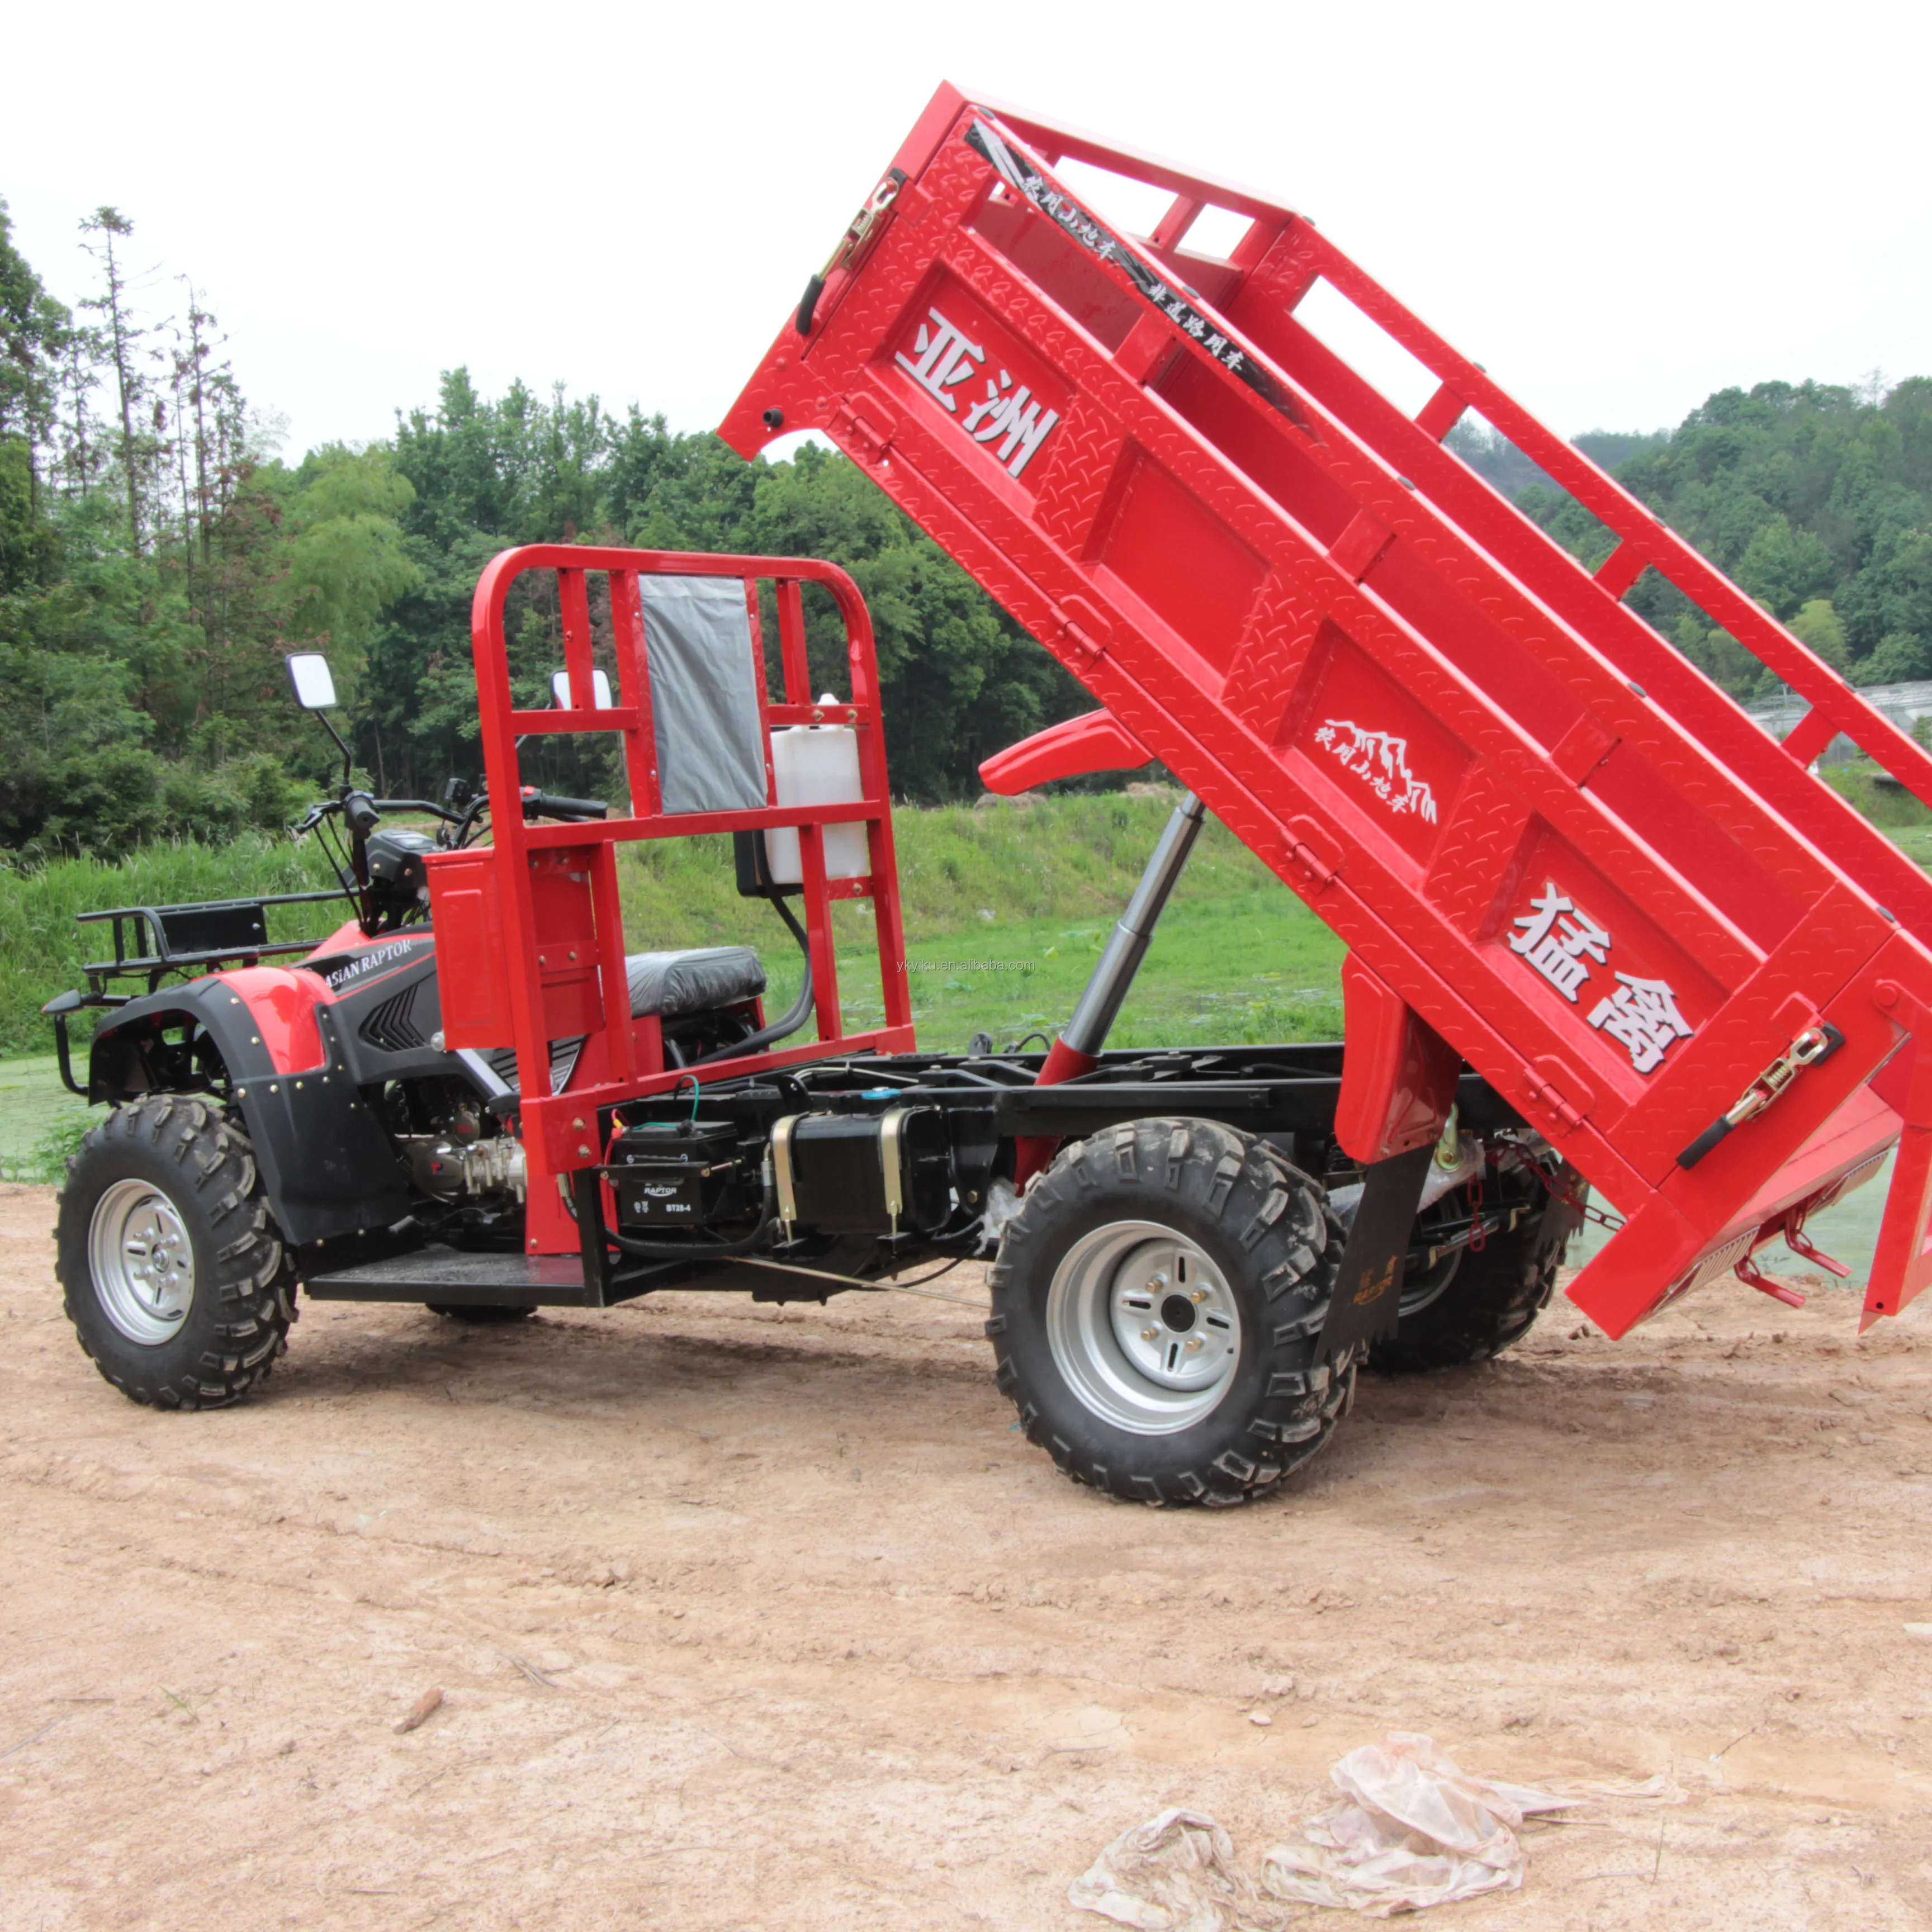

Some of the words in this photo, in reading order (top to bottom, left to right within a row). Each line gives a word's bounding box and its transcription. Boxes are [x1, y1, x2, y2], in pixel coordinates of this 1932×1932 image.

[1022, 176, 1116, 260] 农用山地车
[1148, 283, 1244, 370] 非道路用车
[894, 306, 1060, 479] 亚洲
[1315, 727, 1409, 813] 农用山地车
[361, 939, 412, 972] RAPTOR
[1507, 882, 1694, 1074] 猛禽
